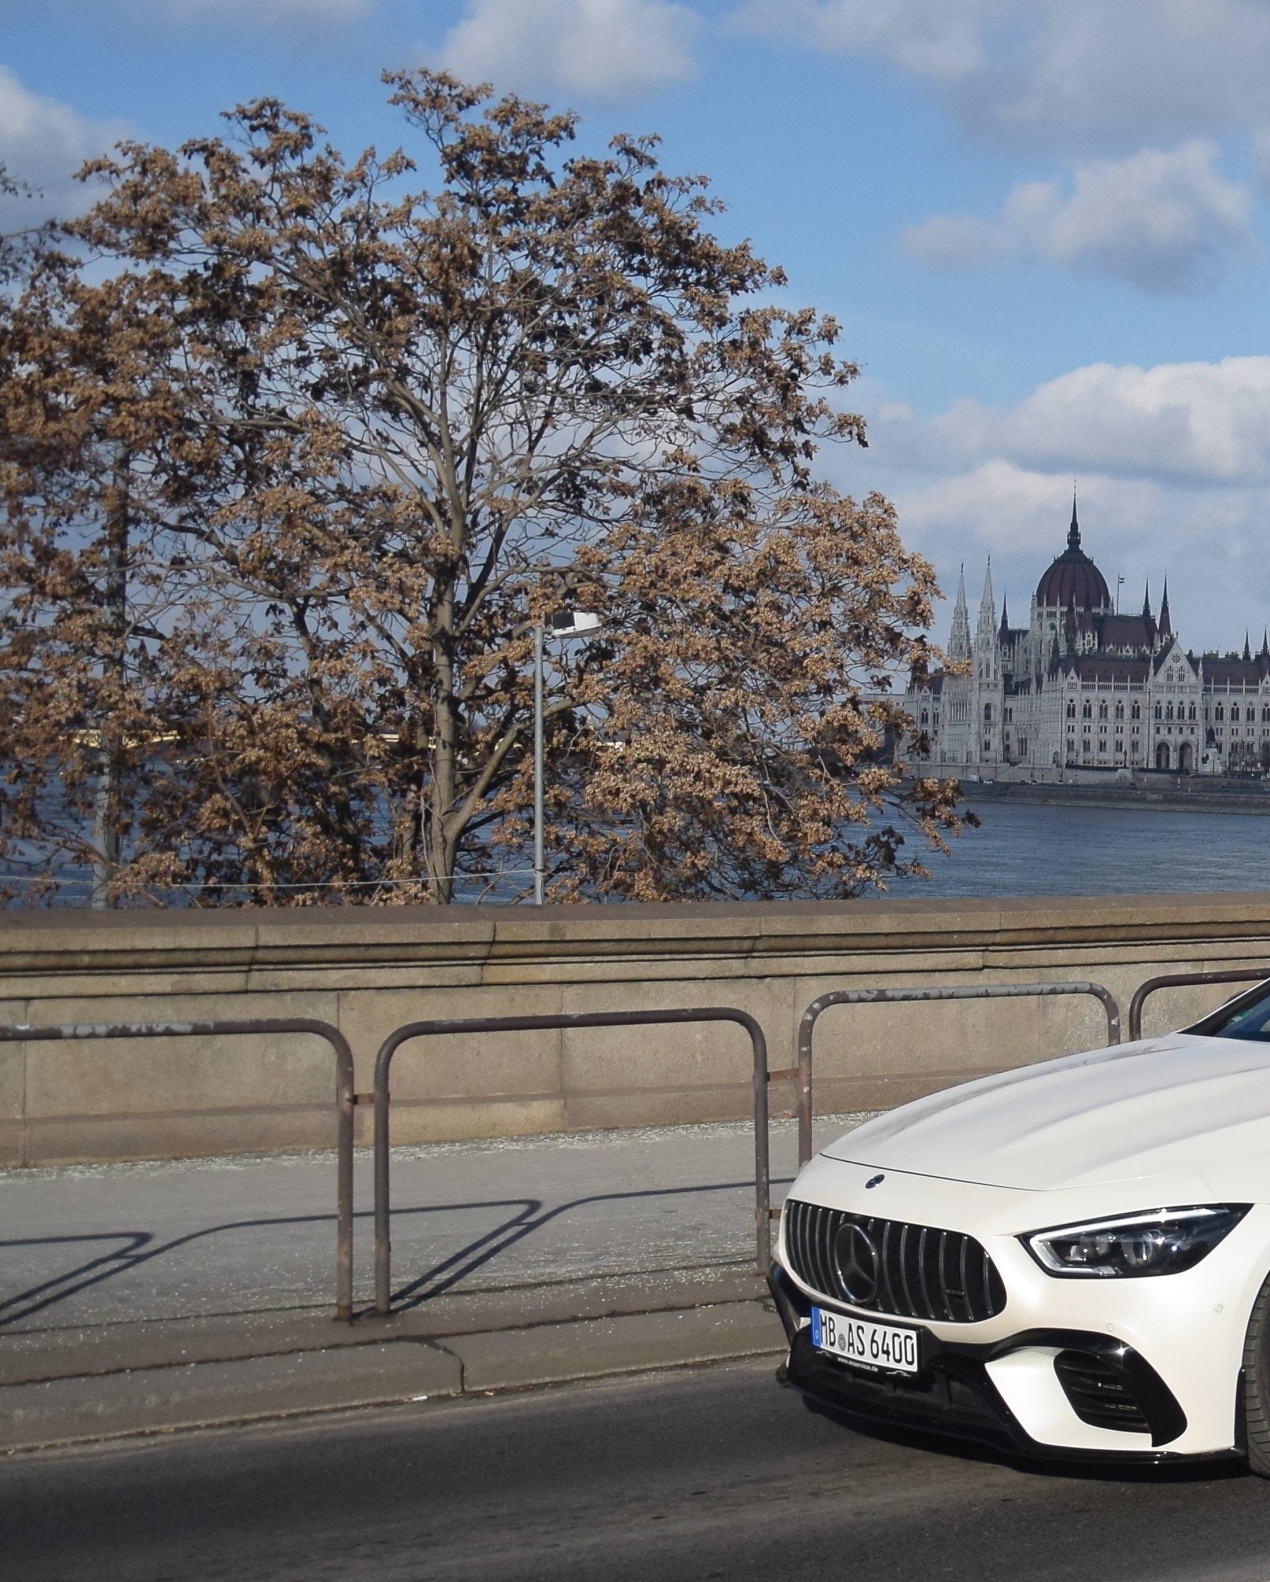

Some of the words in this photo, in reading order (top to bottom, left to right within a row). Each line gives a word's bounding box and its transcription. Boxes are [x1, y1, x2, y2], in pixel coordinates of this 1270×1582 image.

[820, 1312, 836, 1347] MB
[847, 1322, 865, 1356] AS
[870, 1328, 915, 1366] 6400
